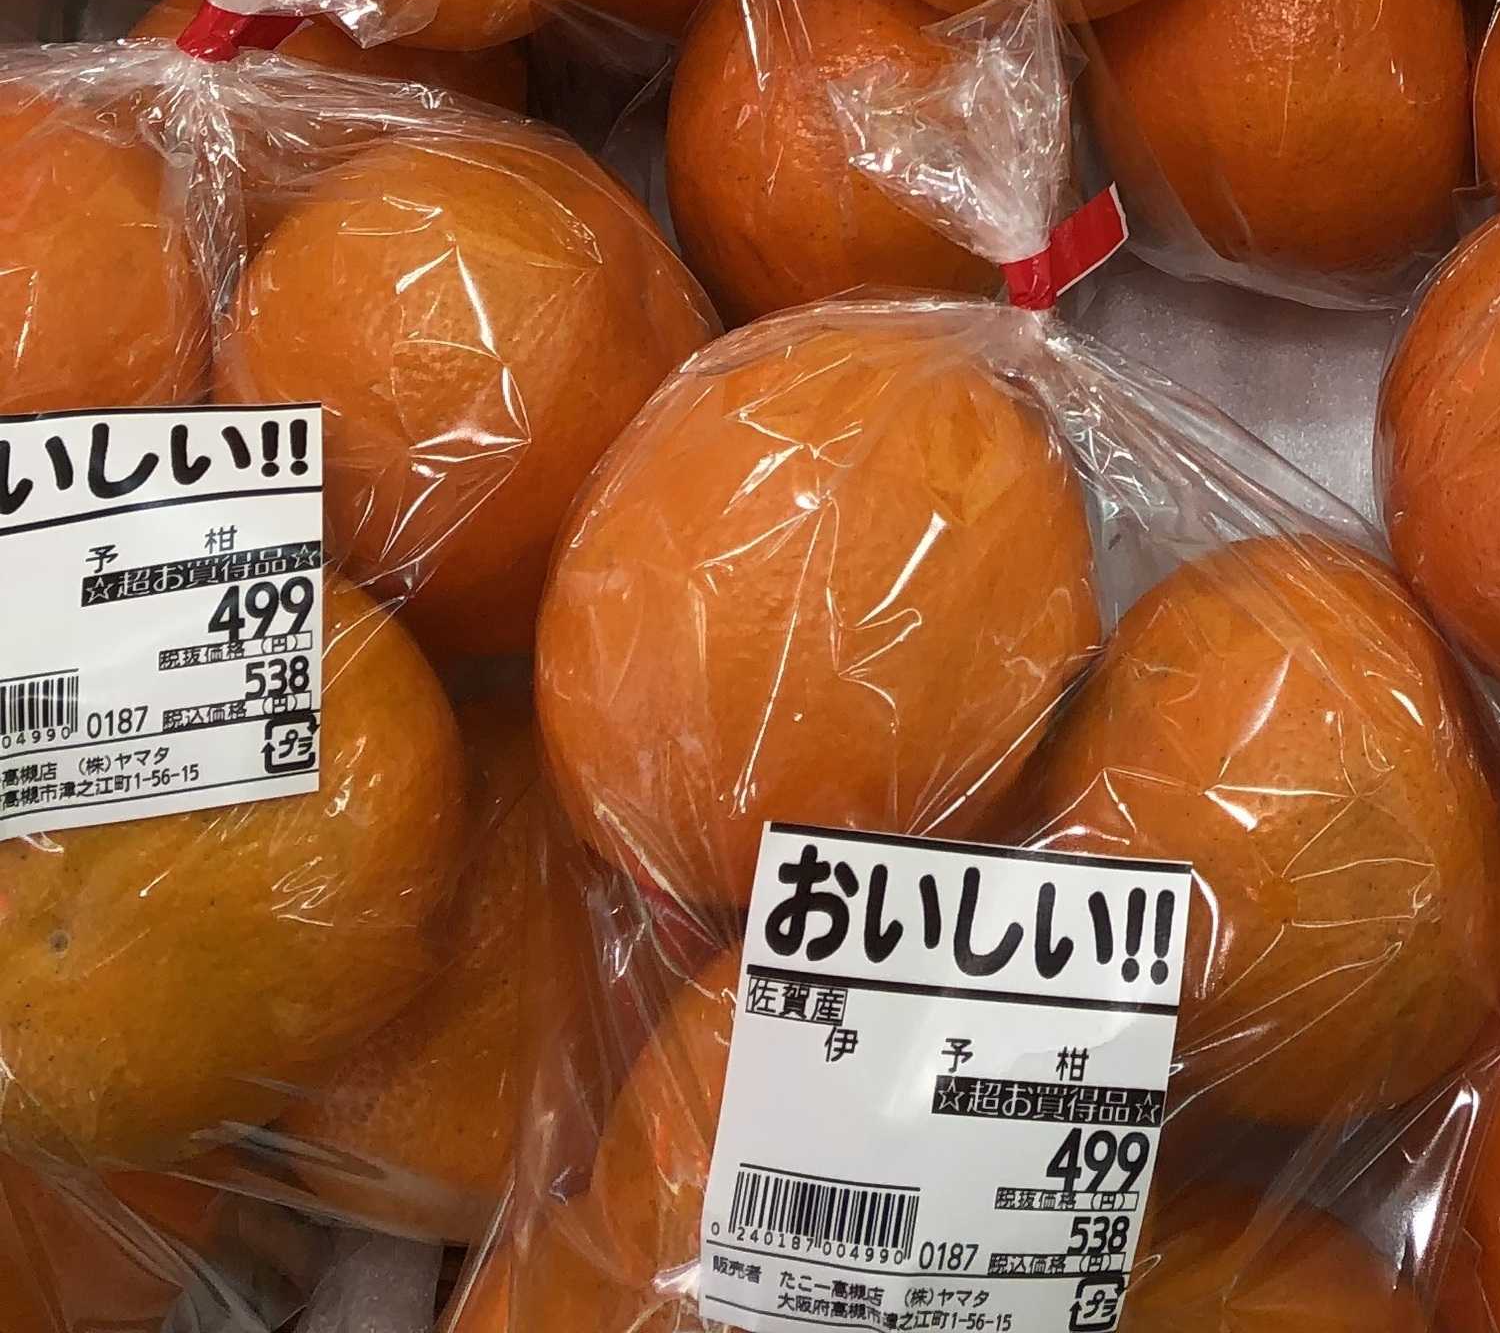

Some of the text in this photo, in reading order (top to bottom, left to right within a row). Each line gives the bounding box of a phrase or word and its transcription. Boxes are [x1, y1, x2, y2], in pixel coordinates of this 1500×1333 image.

[208, 576, 314, 642] 499
[159, 642, 244, 670] 税抜価格
[245, 655, 309, 701] 538
[87, 706, 148, 738] 0187
[163, 701, 247, 732] 税込価格
[279, 729, 313, 759] プラ
[765, 845, 1175, 986] おいしい!!
[746, 976, 846, 1026] 佐賀産
[1046, 1128, 1150, 1192] 499
[995, 1188, 1076, 1209] 税抜価格
[1067, 1216, 1130, 1254] 538
[712, 1255, 762, 1284] 販売者
[920, 1241, 979, 1271] 0187
[988, 1254, 1065, 1274] 税込価格
[1083, 1290, 1117, 1318] プラ
